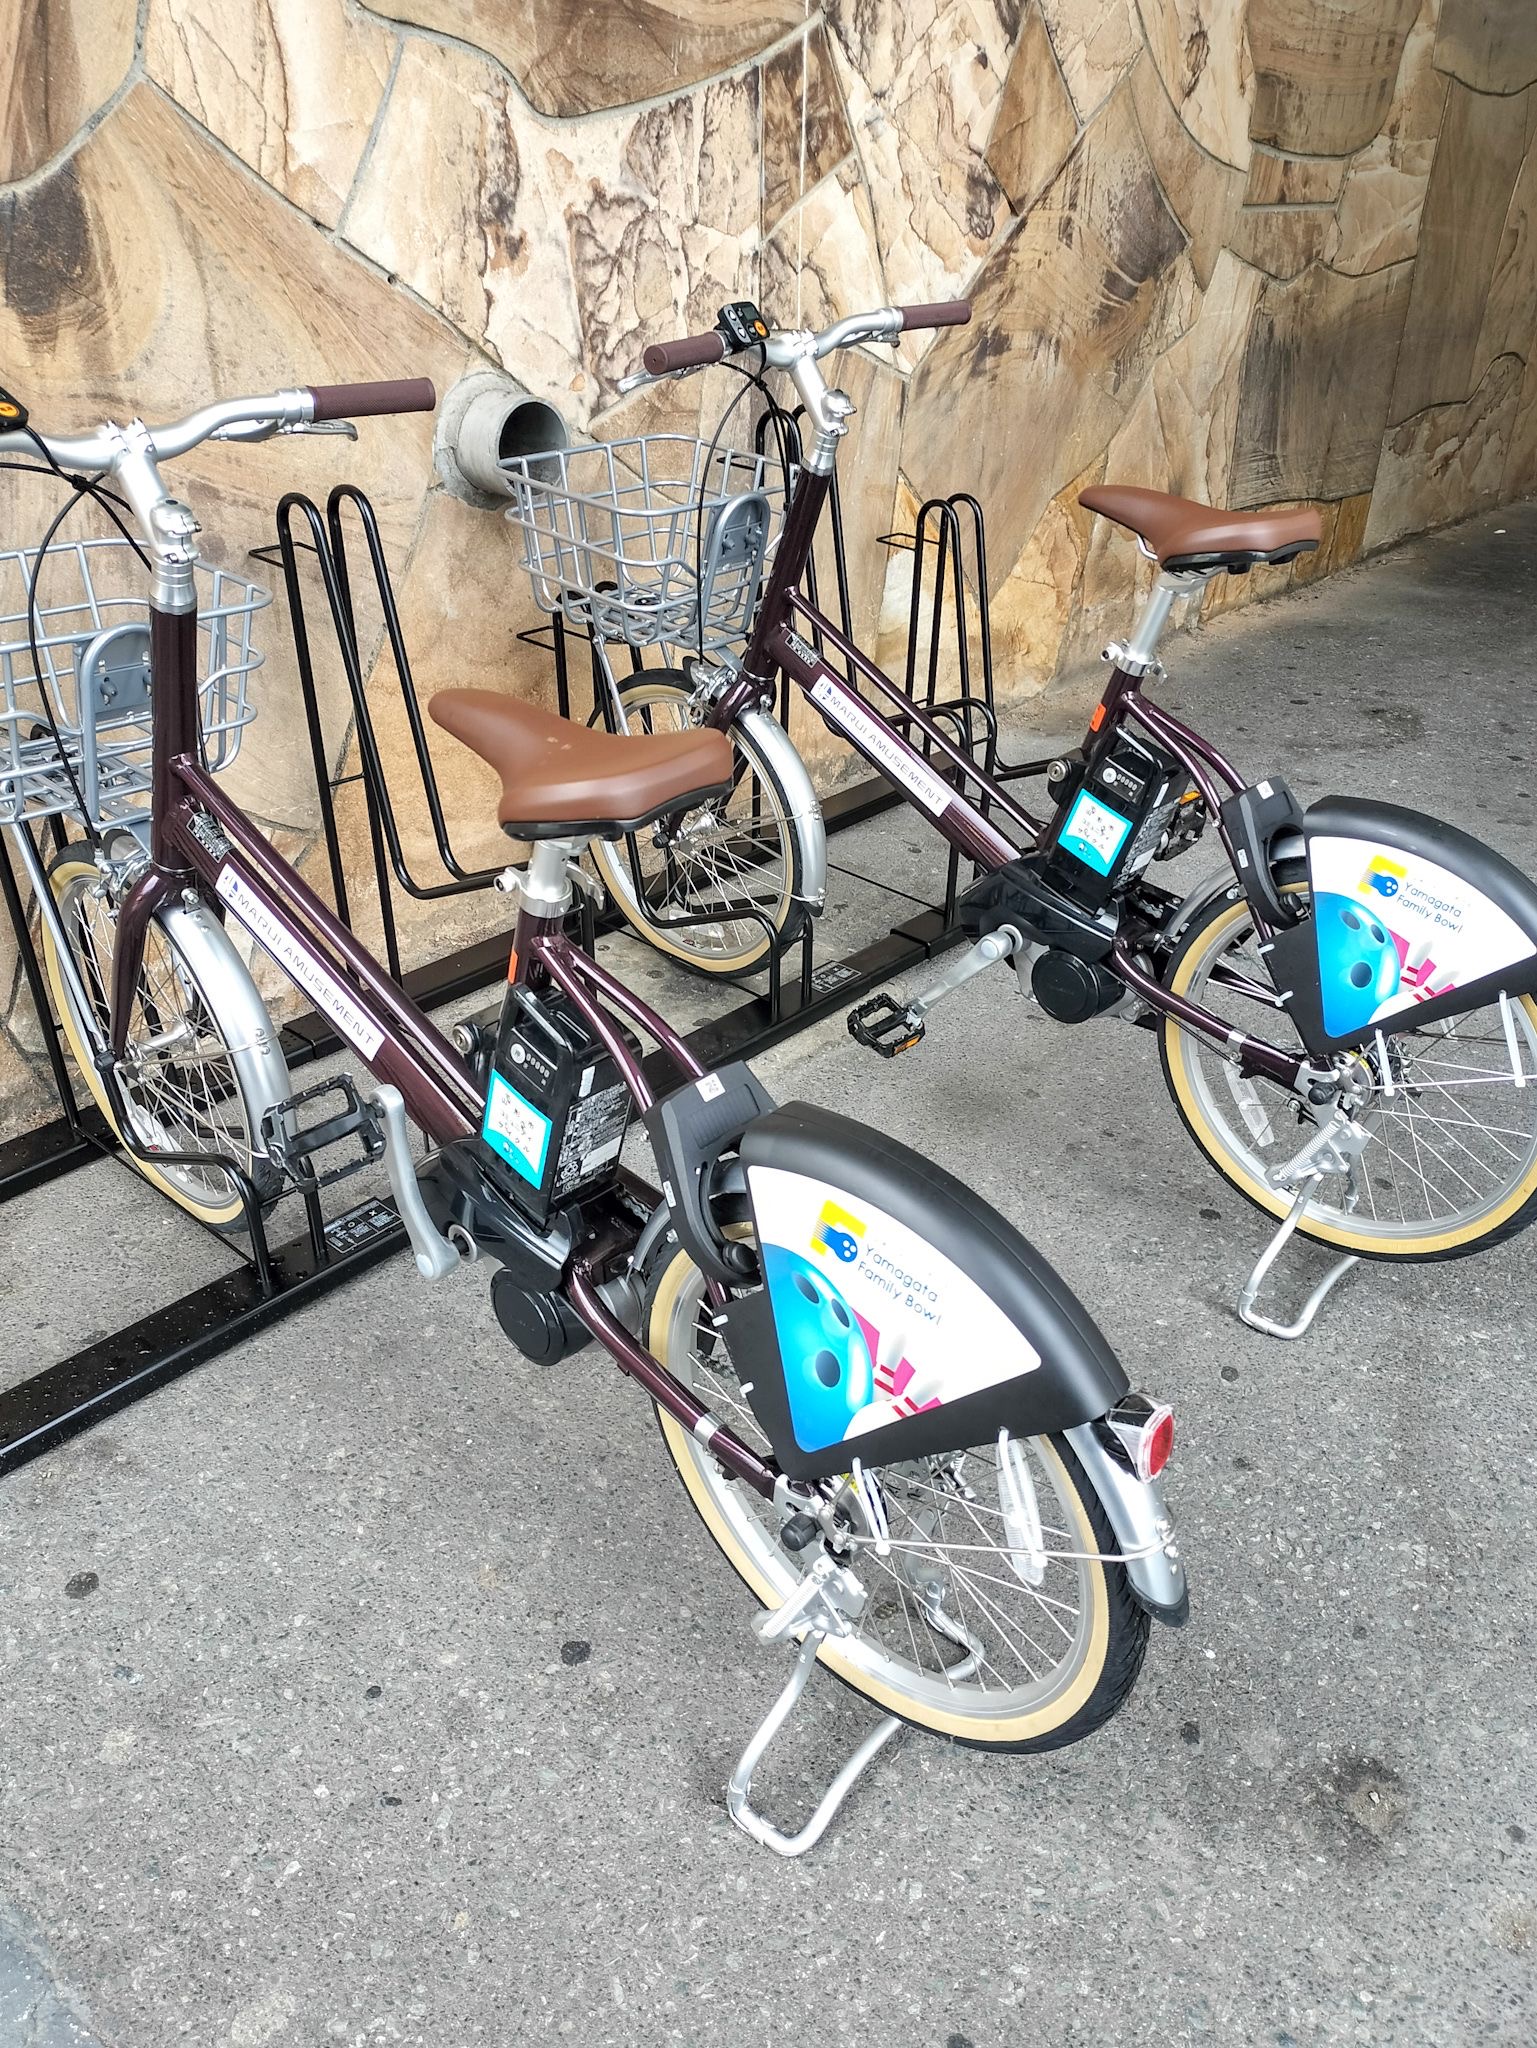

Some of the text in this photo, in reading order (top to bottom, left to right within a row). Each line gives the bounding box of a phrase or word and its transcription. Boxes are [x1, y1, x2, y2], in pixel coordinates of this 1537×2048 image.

[830, 697, 943, 804] MARUI AMUSEMENT
[1397, 895, 1463, 933] Family Bowl
[1405, 882, 1462, 918] Yamagata
[237, 893, 375, 1045] MARUI AMUSEMENT
[858, 1261, 941, 1325] Family Bowl
[866, 1244, 938, 1303] Yamagata
